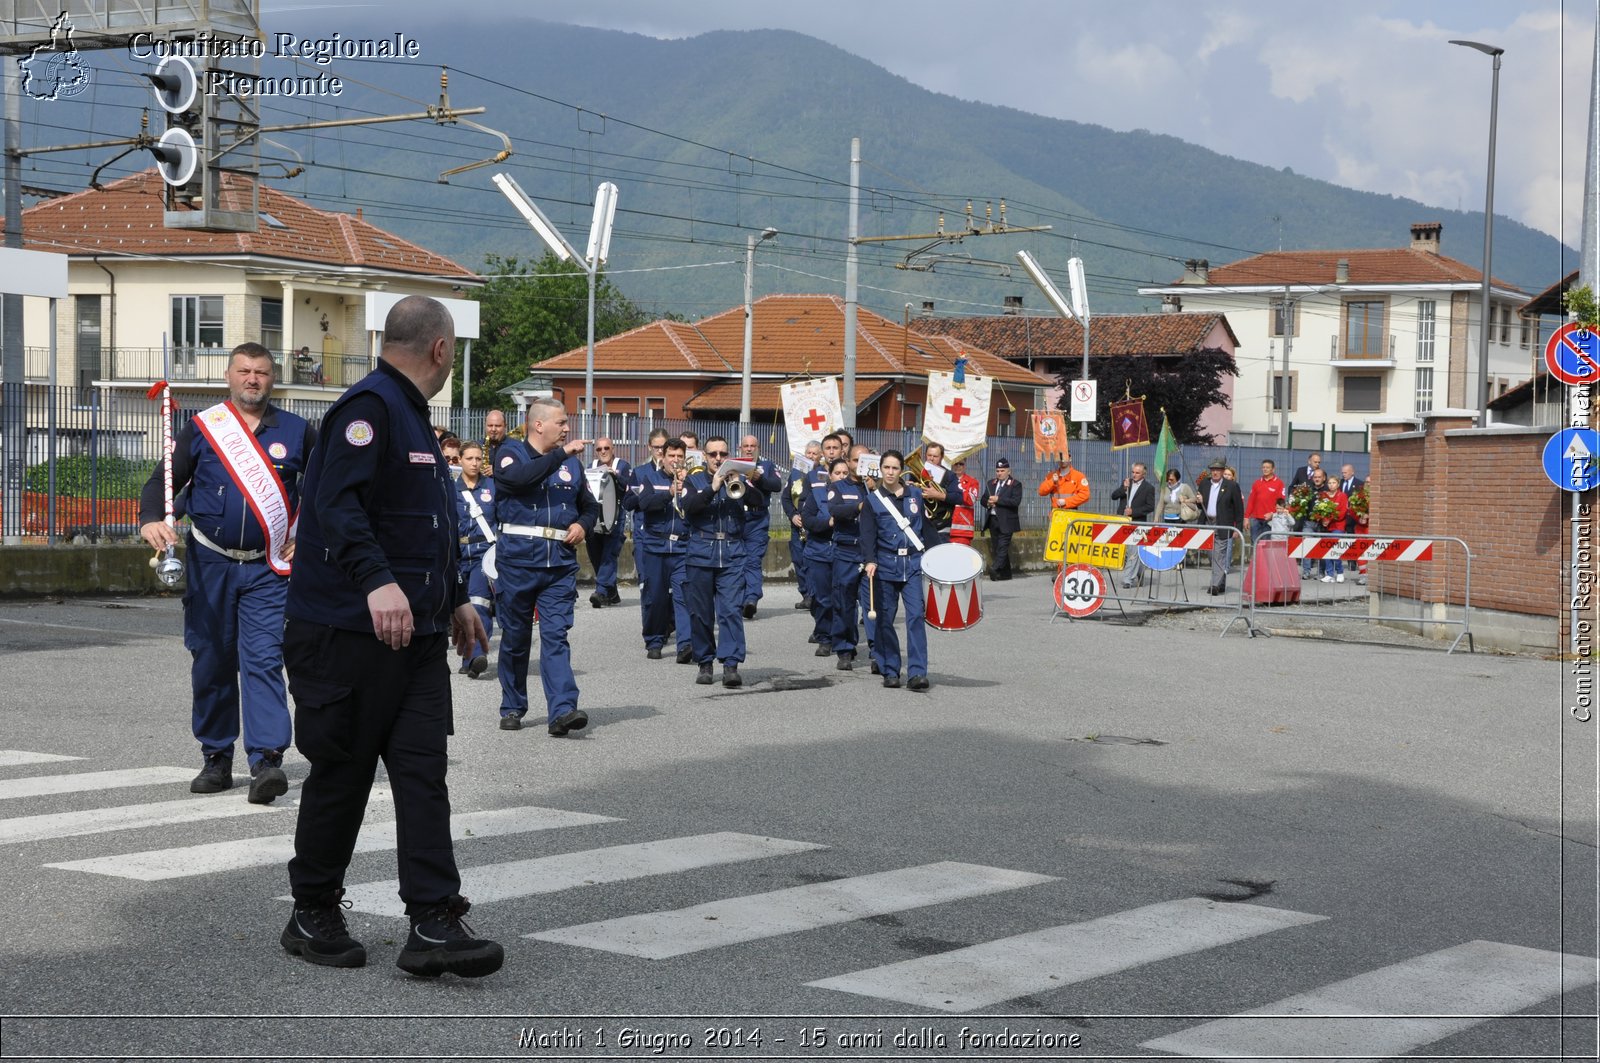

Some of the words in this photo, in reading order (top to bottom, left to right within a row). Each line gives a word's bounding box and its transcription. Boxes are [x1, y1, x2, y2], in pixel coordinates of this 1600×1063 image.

[222, 431, 256, 469] CROCE
[242, 462, 276, 504] ROSSA
[1049, 540, 1120, 559] CANTIERE
[1320, 541, 1357, 550] COMUNE
[1360, 542, 1370, 550] DI
[1371, 542, 1401, 551] MATHI
[1066, 577, 1095, 602] 30
